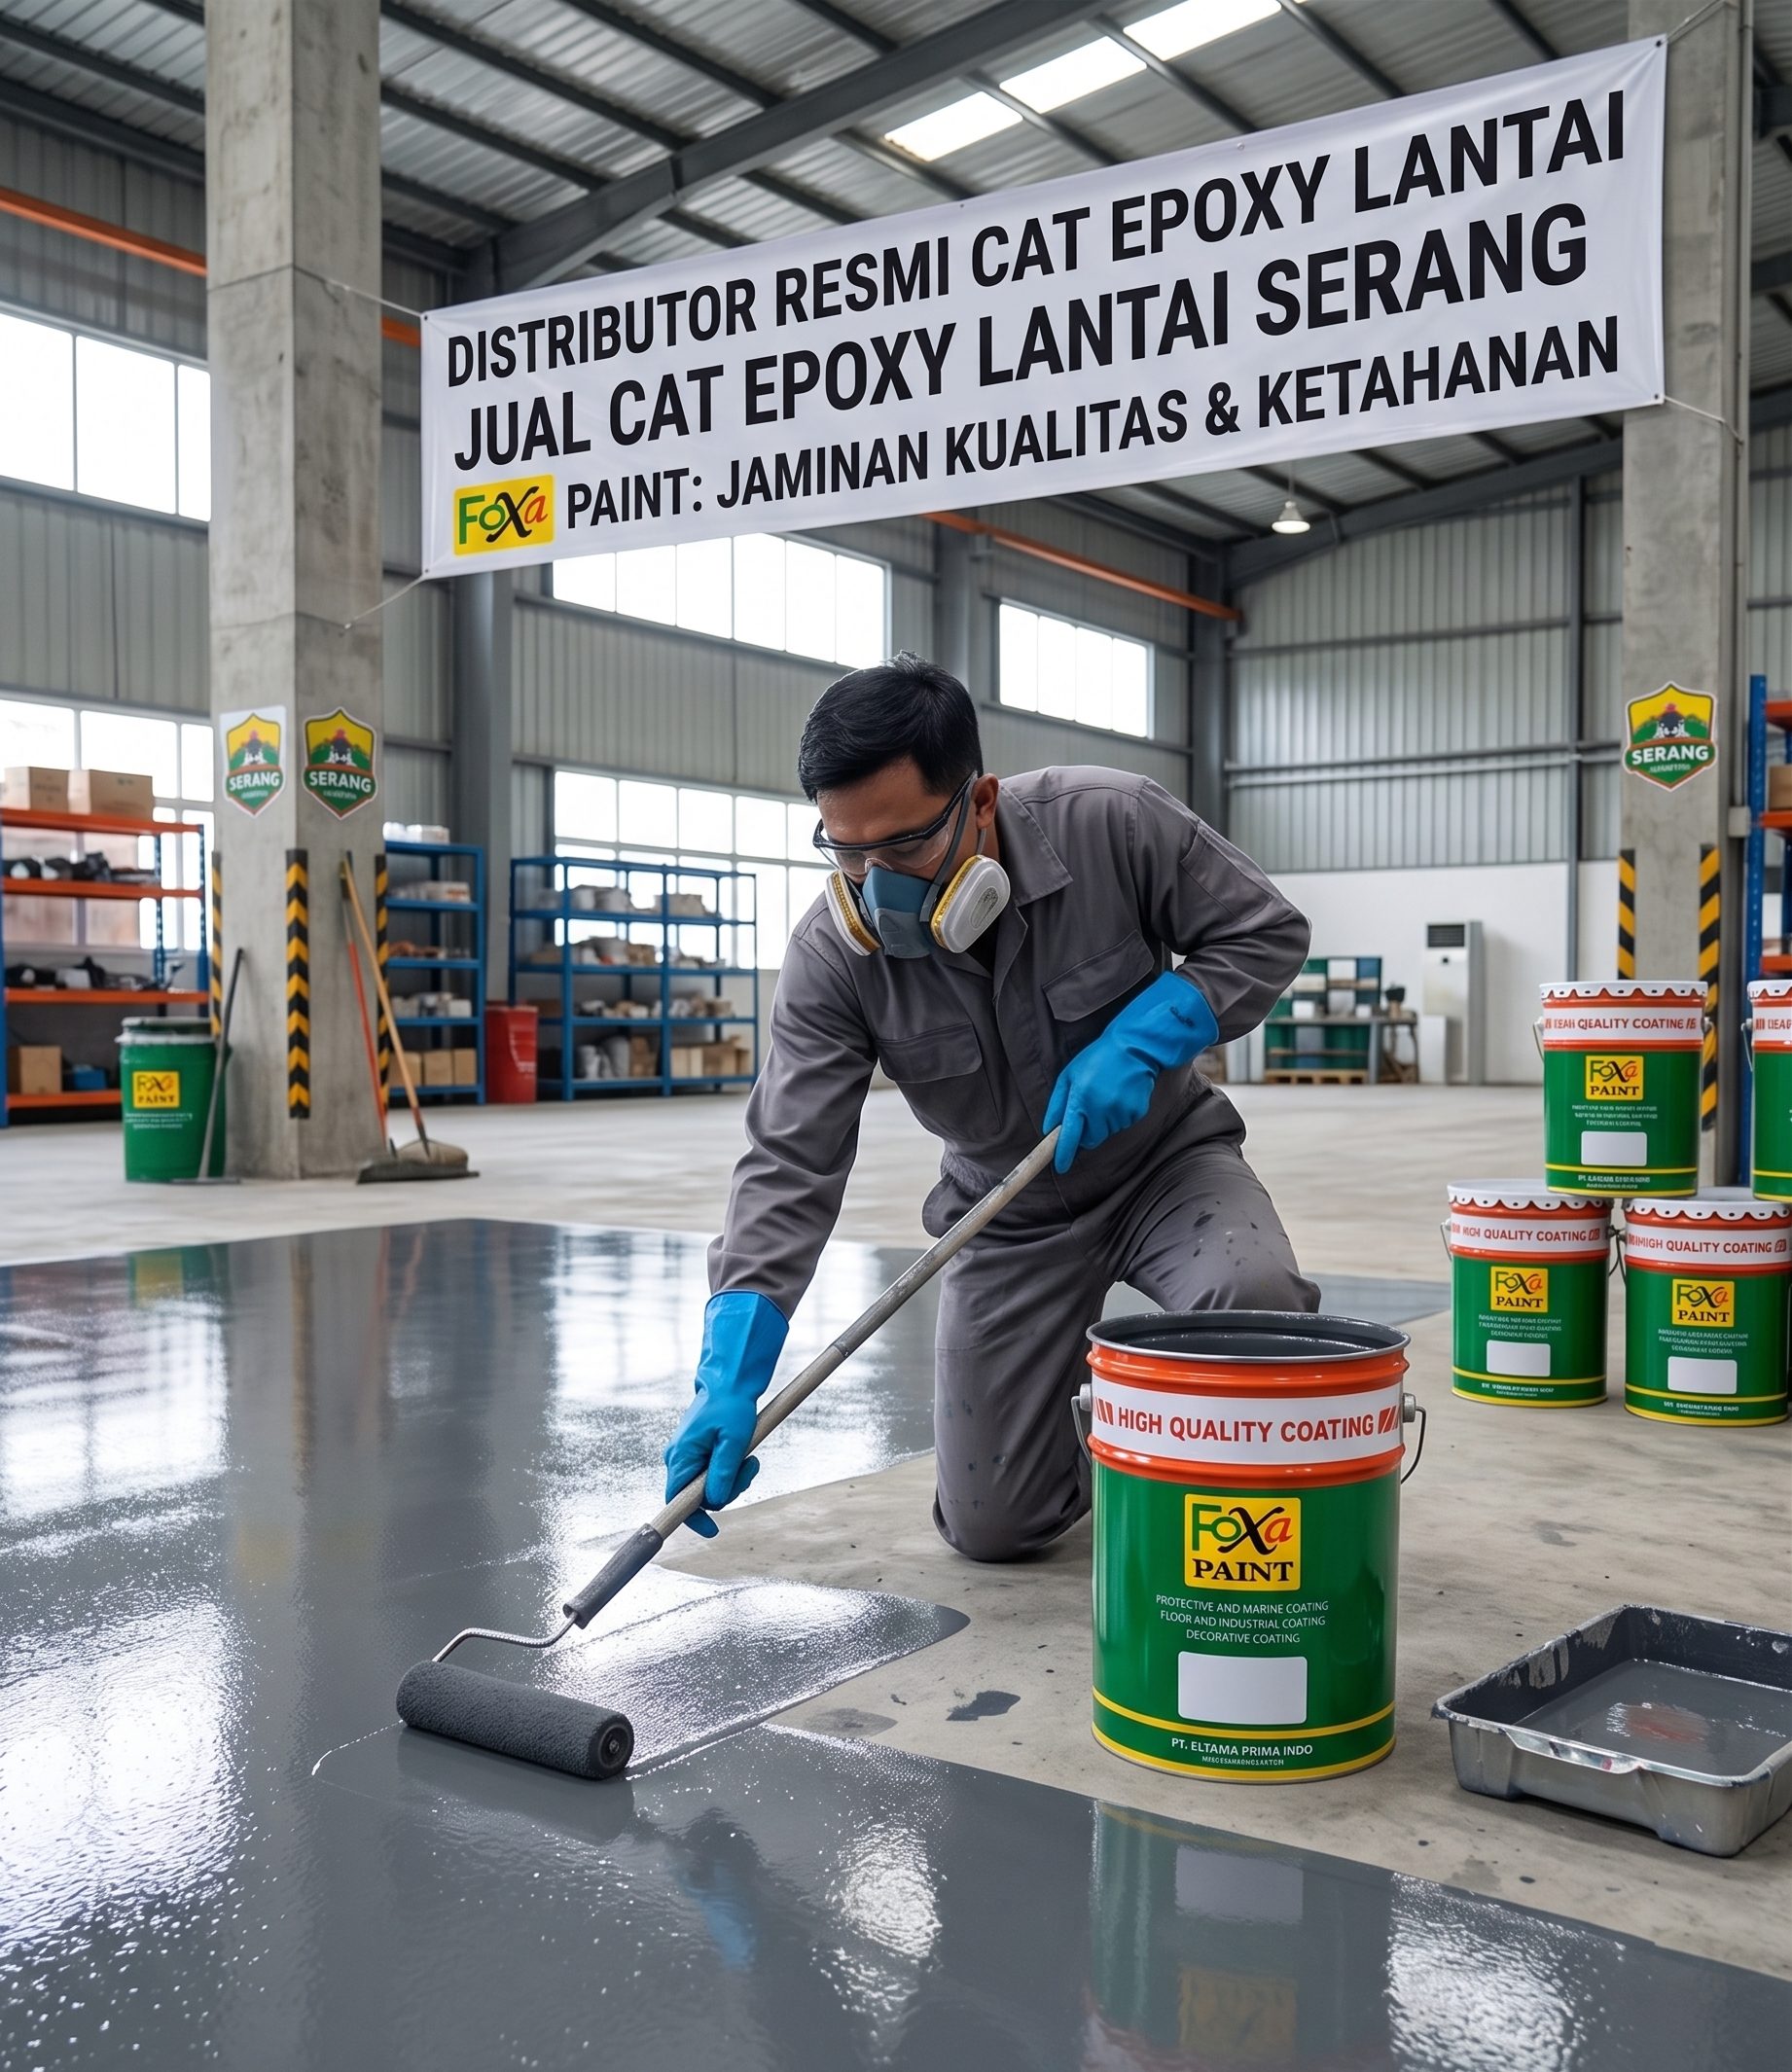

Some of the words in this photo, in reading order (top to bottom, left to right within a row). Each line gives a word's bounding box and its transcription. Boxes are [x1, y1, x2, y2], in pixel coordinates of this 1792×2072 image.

[448, 278, 757, 388] DISTRIBUTOR
[775, 235, 950, 327] RESMI
[971, 206, 1091, 288] CAT
[1112, 154, 1331, 263] EPOXY
[1354, 89, 1624, 214] LANTAI
[454, 390, 591, 471] JUAL
[609, 364, 724, 447] CAT
[744, 322, 957, 426] EPOXY
[979, 269, 1229, 387] LANTAI
[1255, 202, 1587, 337] SERANG
[567, 467, 702, 529] PAINT:
[716, 430, 928, 509] JAMINAN
[946, 389, 1188, 477] KUALITAS
[1204, 381, 1241, 436] &
[1259, 315, 1618, 429] KETAHANAN
[1631, 745, 1709, 766] SERANG
[229, 771, 281, 792] SERANG
[308, 770, 372, 793] SERANG
[1590, 1085, 1640, 1096] PAINT
[1484, 1229, 1533, 1240] QUALITY
[1536, 1230, 1587, 1241] COATING
[1666, 1239, 1720, 1253] QUALITY
[1723, 1241, 1773, 1254] COATING
[1495, 1296, 1544, 1308] PAINT
[1677, 1309, 1731, 1323] PAINT
[1118, 1407, 1163, 1435] HIGH
[1168, 1416, 1275, 1443] QUALITY
[1279, 1413, 1375, 1443] COATING
[1192, 1557, 1294, 1583] PAINT
[1156, 1594, 1214, 1612] PROTECTIVE
[1216, 1603, 1241, 1615] AND
[1242, 1604, 1283, 1615] MARINE
[1285, 1600, 1329, 1614] COATING
[1160, 1610, 1193, 1624] FLOOR
[1194, 1615, 1217, 1626] AND
[1218, 1618, 1280, 1629] INDUSTRIAL
[1281, 1615, 1326, 1628] COATING
[1186, 1628, 1250, 1644] DECORATIVE
[1252, 1632, 1301, 1644] COATING
[1171, 1737, 1188, 1750] PT.
[1191, 1741, 1238, 1756] ELTAMA
[1241, 1746, 1281, 1757] PRIMA
[1283, 1744, 1313, 1756] INDO
